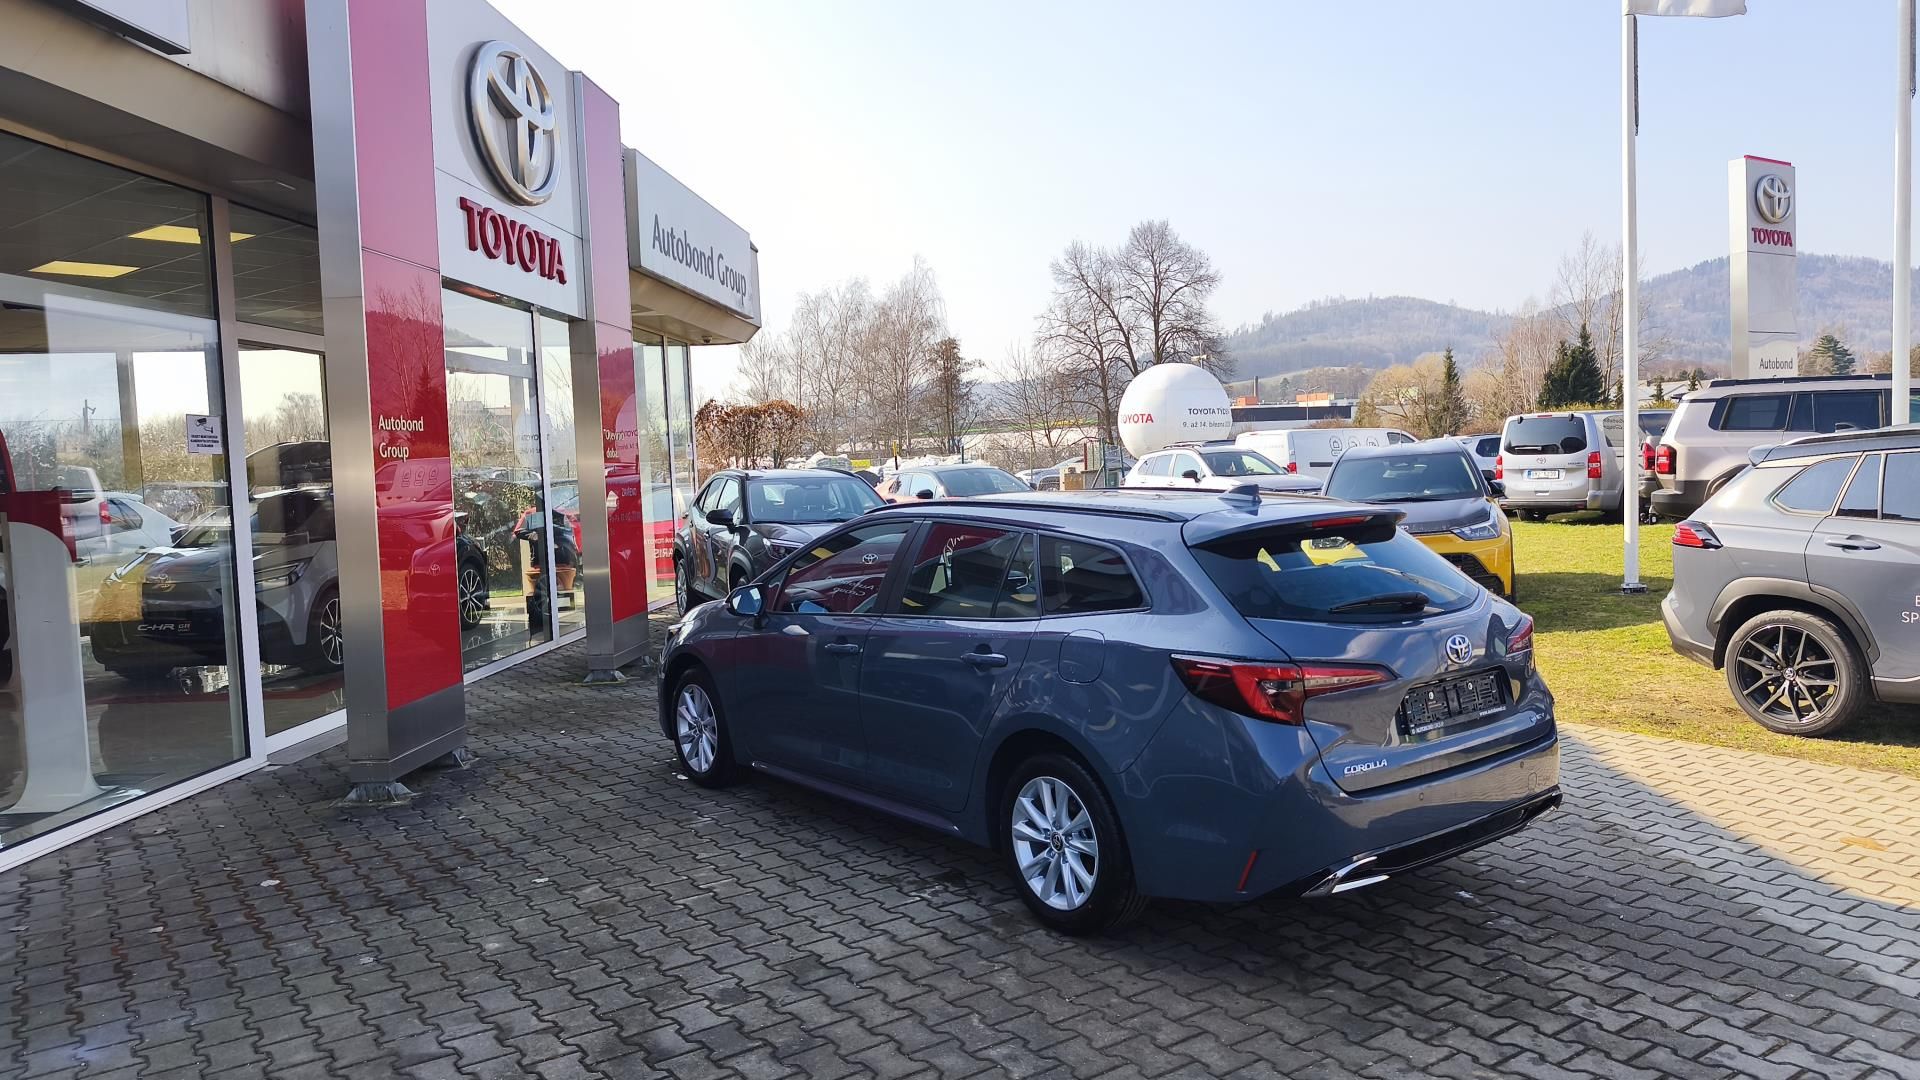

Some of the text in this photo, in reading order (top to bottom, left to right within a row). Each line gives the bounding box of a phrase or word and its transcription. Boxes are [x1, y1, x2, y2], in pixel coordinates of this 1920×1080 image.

[459, 196, 567, 285] TOYOTA
[1751, 227, 1793, 247] TOYOTA
[652, 214, 747, 306] Autobond Group
[1759, 357, 1793, 370] Autobond
[378, 415, 424, 432] Autobond
[379, 443, 409, 462] Group
[137, 623, 175, 631] C-HR
[1344, 758, 1388, 774] COROLLA
